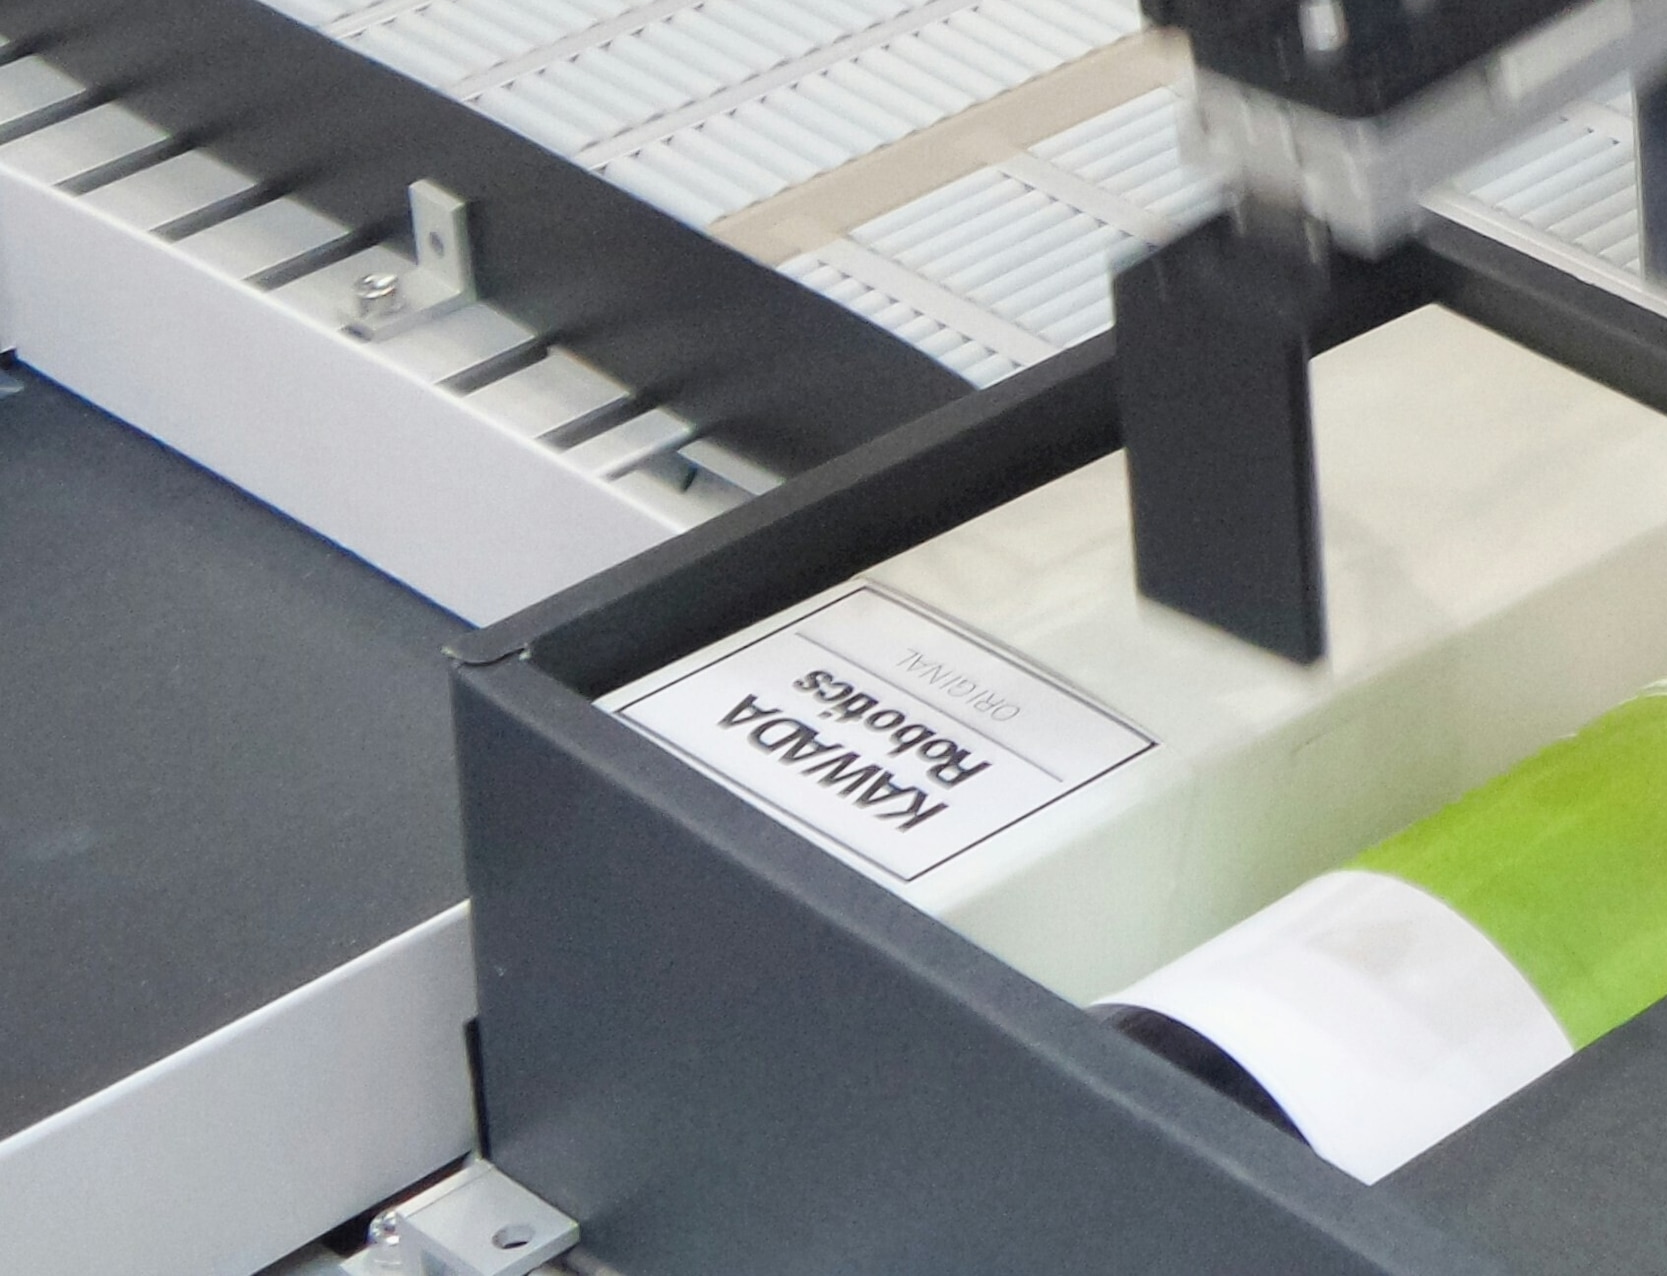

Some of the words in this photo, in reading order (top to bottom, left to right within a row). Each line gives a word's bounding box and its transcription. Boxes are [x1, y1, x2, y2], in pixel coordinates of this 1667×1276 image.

[792, 668, 992, 789] Robotics
[896, 646, 1021, 723] ORIGINAL
[716, 693, 950, 833] KAWADA
